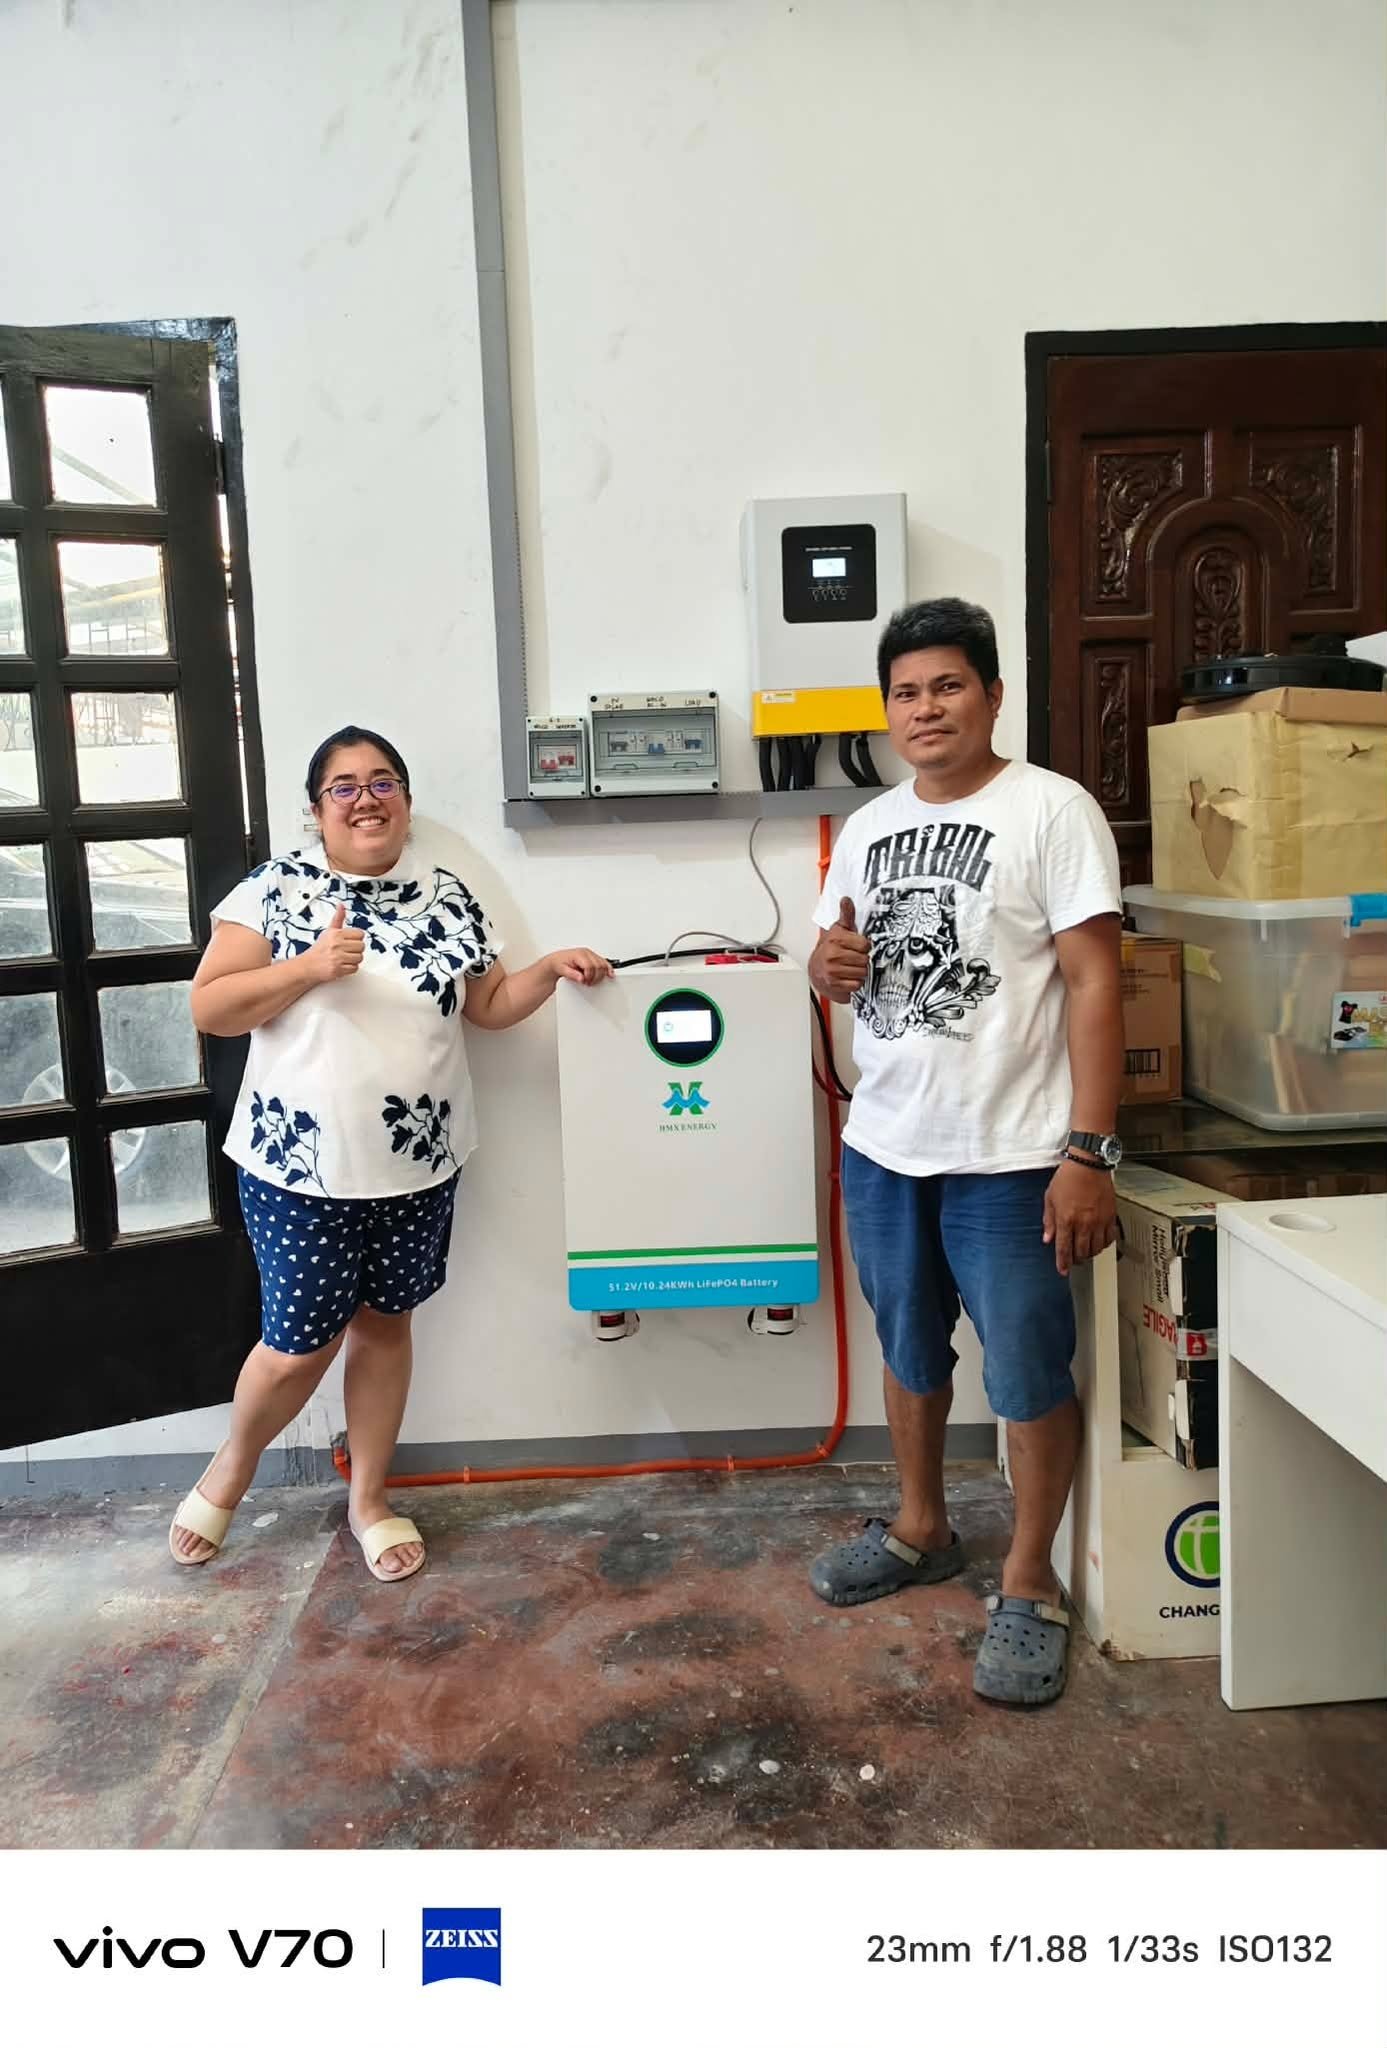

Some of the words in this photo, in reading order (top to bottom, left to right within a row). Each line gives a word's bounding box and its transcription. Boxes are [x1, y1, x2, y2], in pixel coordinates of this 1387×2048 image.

[863, 823, 996, 896] TRIBAL
[681, 1122, 717, 1131] ENERGY
[696, 1279, 738, 1289] LiFePO4
[740, 1278, 778, 1288] Battery
[1159, 1604, 1220, 1618] CHANG
